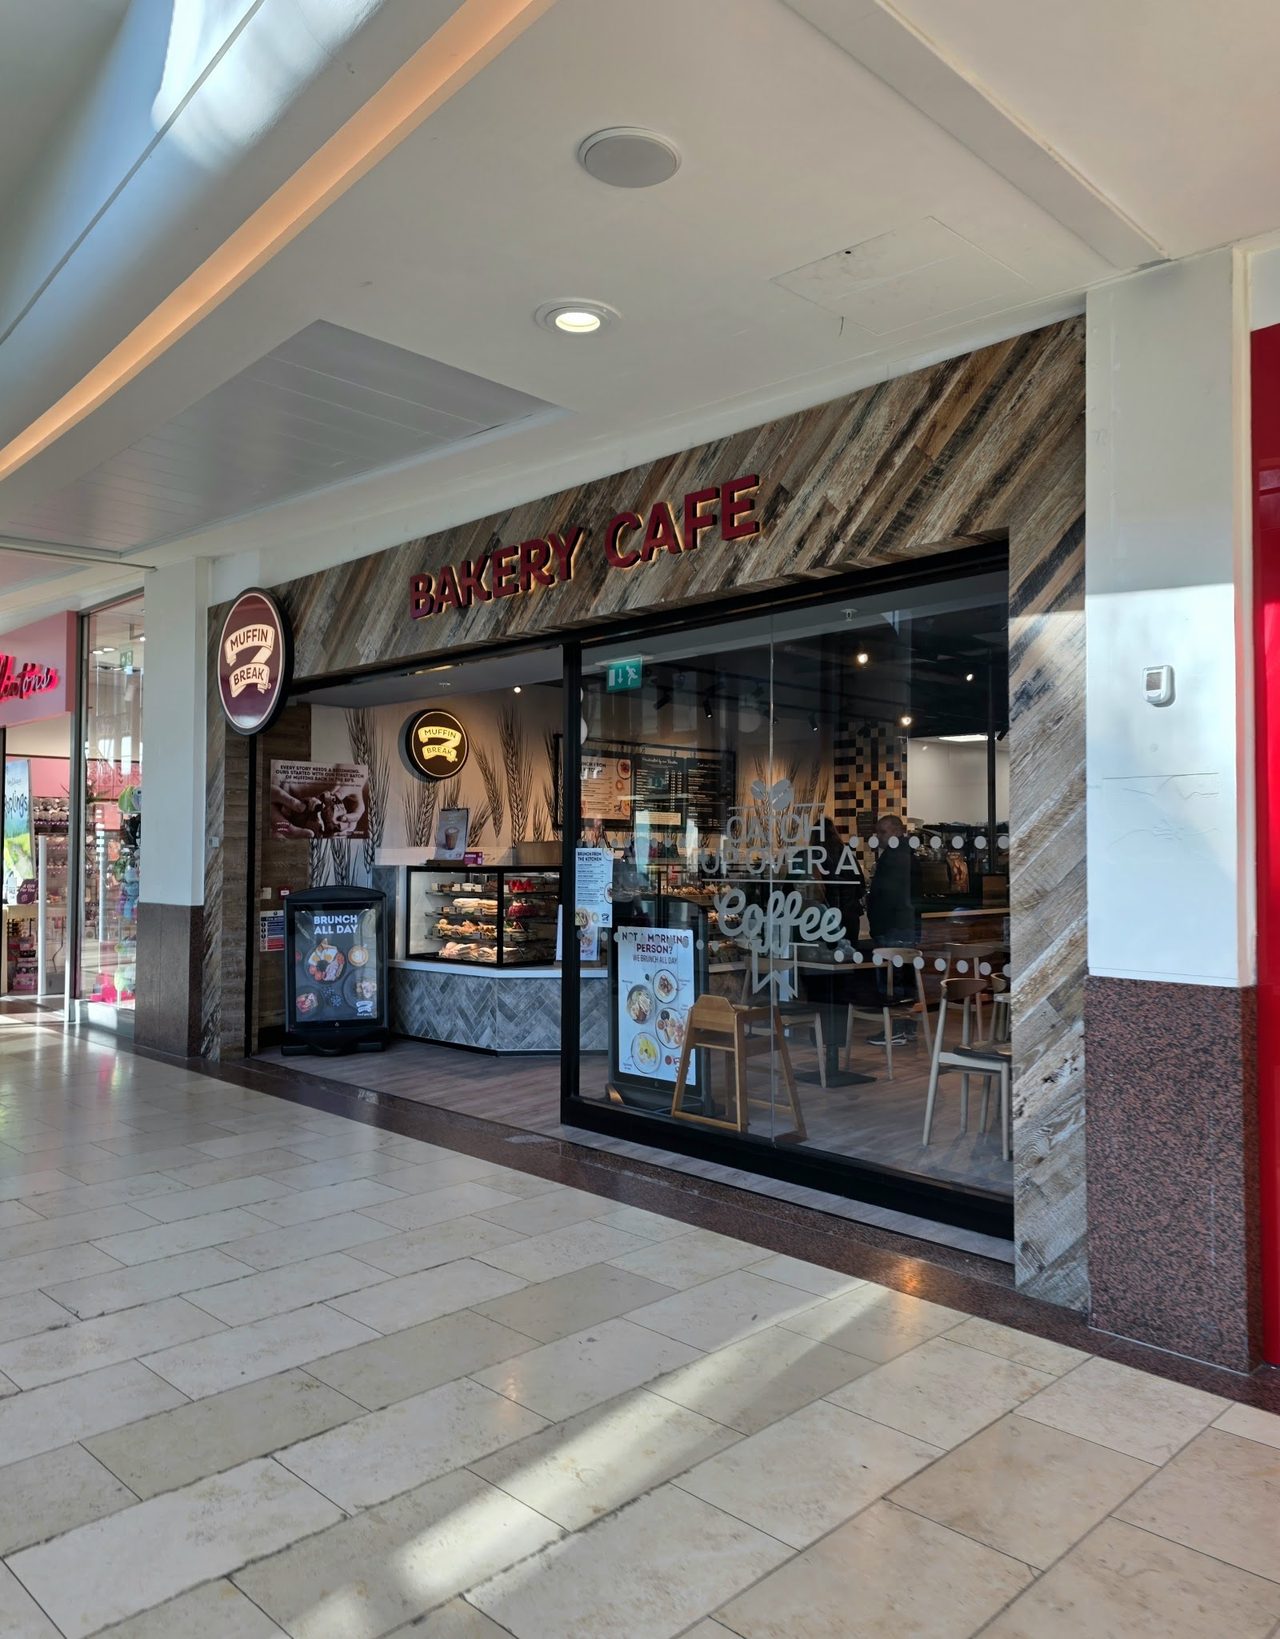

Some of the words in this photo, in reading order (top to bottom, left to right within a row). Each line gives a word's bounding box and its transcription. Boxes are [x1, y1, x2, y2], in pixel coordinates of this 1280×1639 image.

[409, 526, 585, 620] BAKERY
[603, 473, 760, 569] CAFE
[230, 627, 269, 652] MUFFIN
[233, 665, 265, 686] BREAK
[424, 728, 457, 740] MUFFIN
[426, 745, 453, 756] BREAK
[745, 846, 830, 875] OVER
[835, 844, 861, 876] A
[313, 914, 358, 925] BRUNCH
[713, 887, 847, 954] Coffee
[313, 925, 334, 935] ALL
[336, 924, 358, 934] DAY
[636, 943, 673, 955] PERSON?
